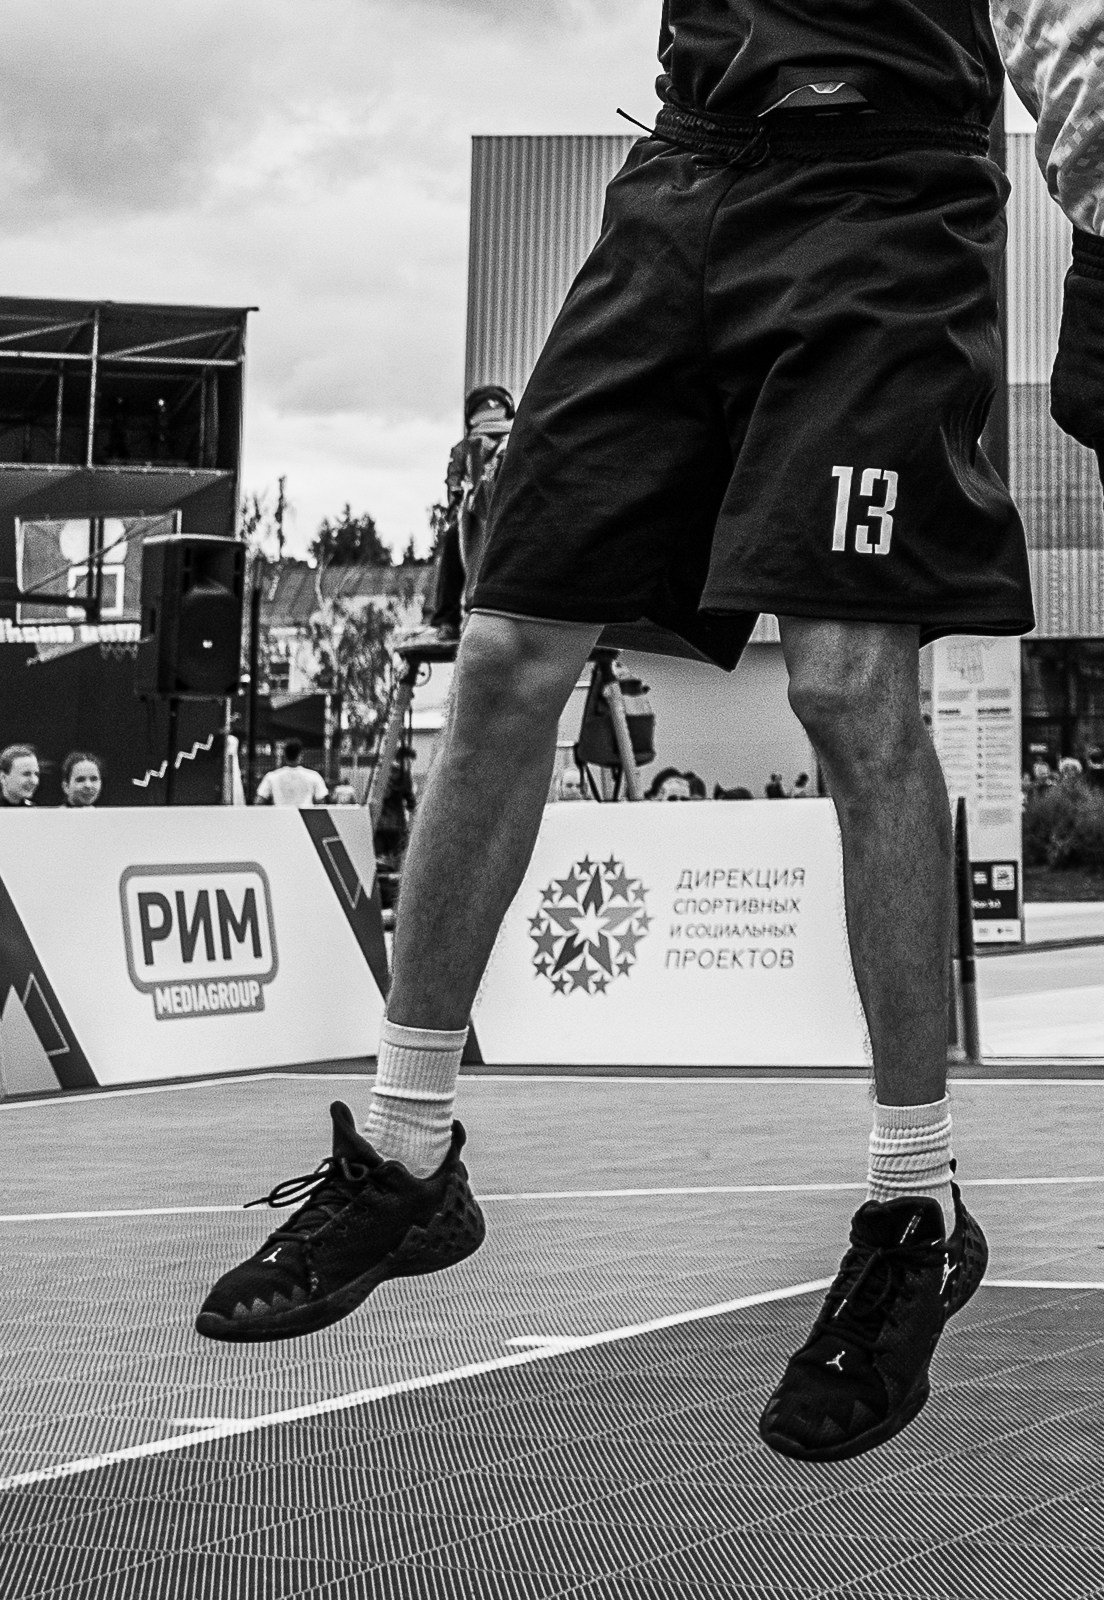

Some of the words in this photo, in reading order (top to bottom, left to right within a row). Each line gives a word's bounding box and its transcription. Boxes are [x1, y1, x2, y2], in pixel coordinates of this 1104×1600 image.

[831, 465, 899, 555] 13
[675, 867, 806, 892] ДИРЕКЦИЯ
[673, 898, 801, 915] СПОРТИВНЫХ
[137, 887, 263, 966] РИМ
[670, 925, 682, 939] И
[685, 923, 797, 940] СОЦИАЛЬНЫХ
[664, 948, 795, 970] ПРОЕКТОВ
[155, 980, 262, 1015] MEDIAGROUP
